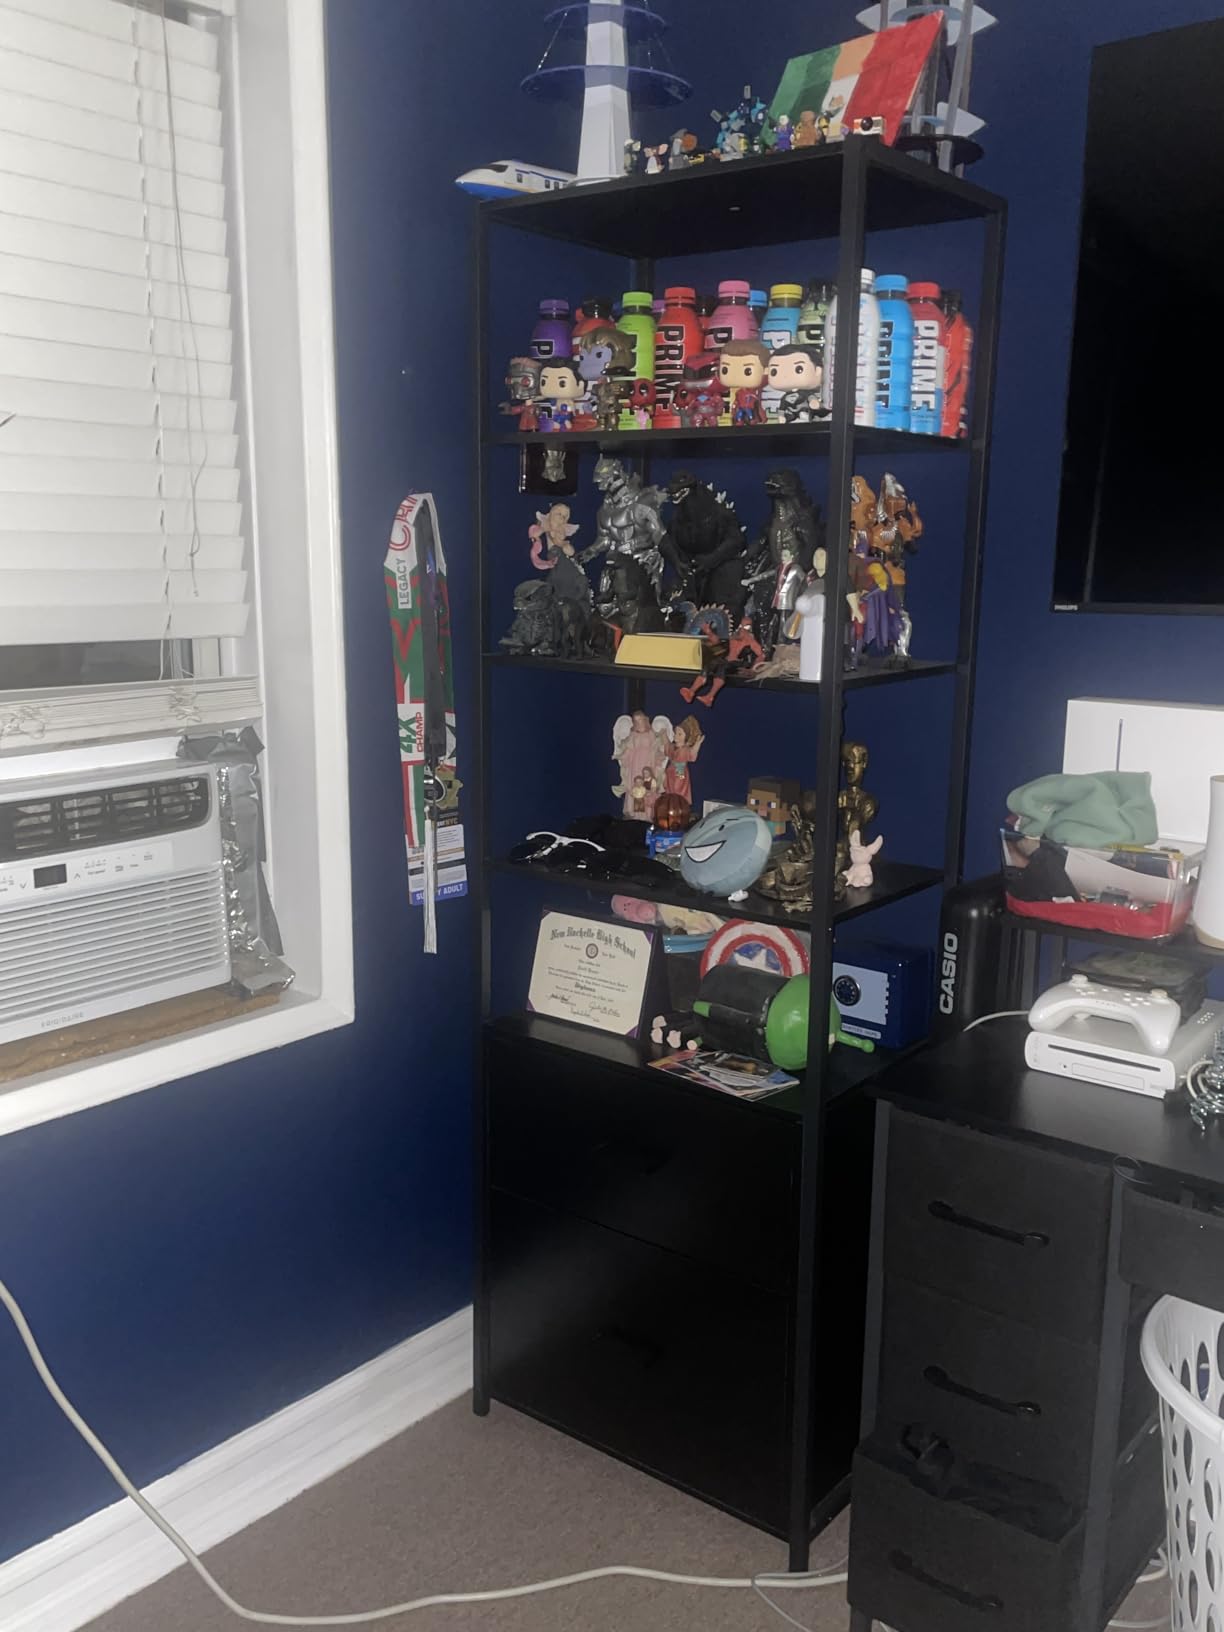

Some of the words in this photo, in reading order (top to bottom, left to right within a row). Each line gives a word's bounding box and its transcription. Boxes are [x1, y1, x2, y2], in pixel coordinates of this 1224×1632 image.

[911, 319, 940, 411] PRIME
[396, 558, 410, 606] LEGACY
[415, 711, 424, 752] CHAMP
[443, 883, 464, 896] ADULT
[551, 929, 565, 940] New
[614, 936, 636, 959] School
[939, 932, 959, 1015] CASIO
